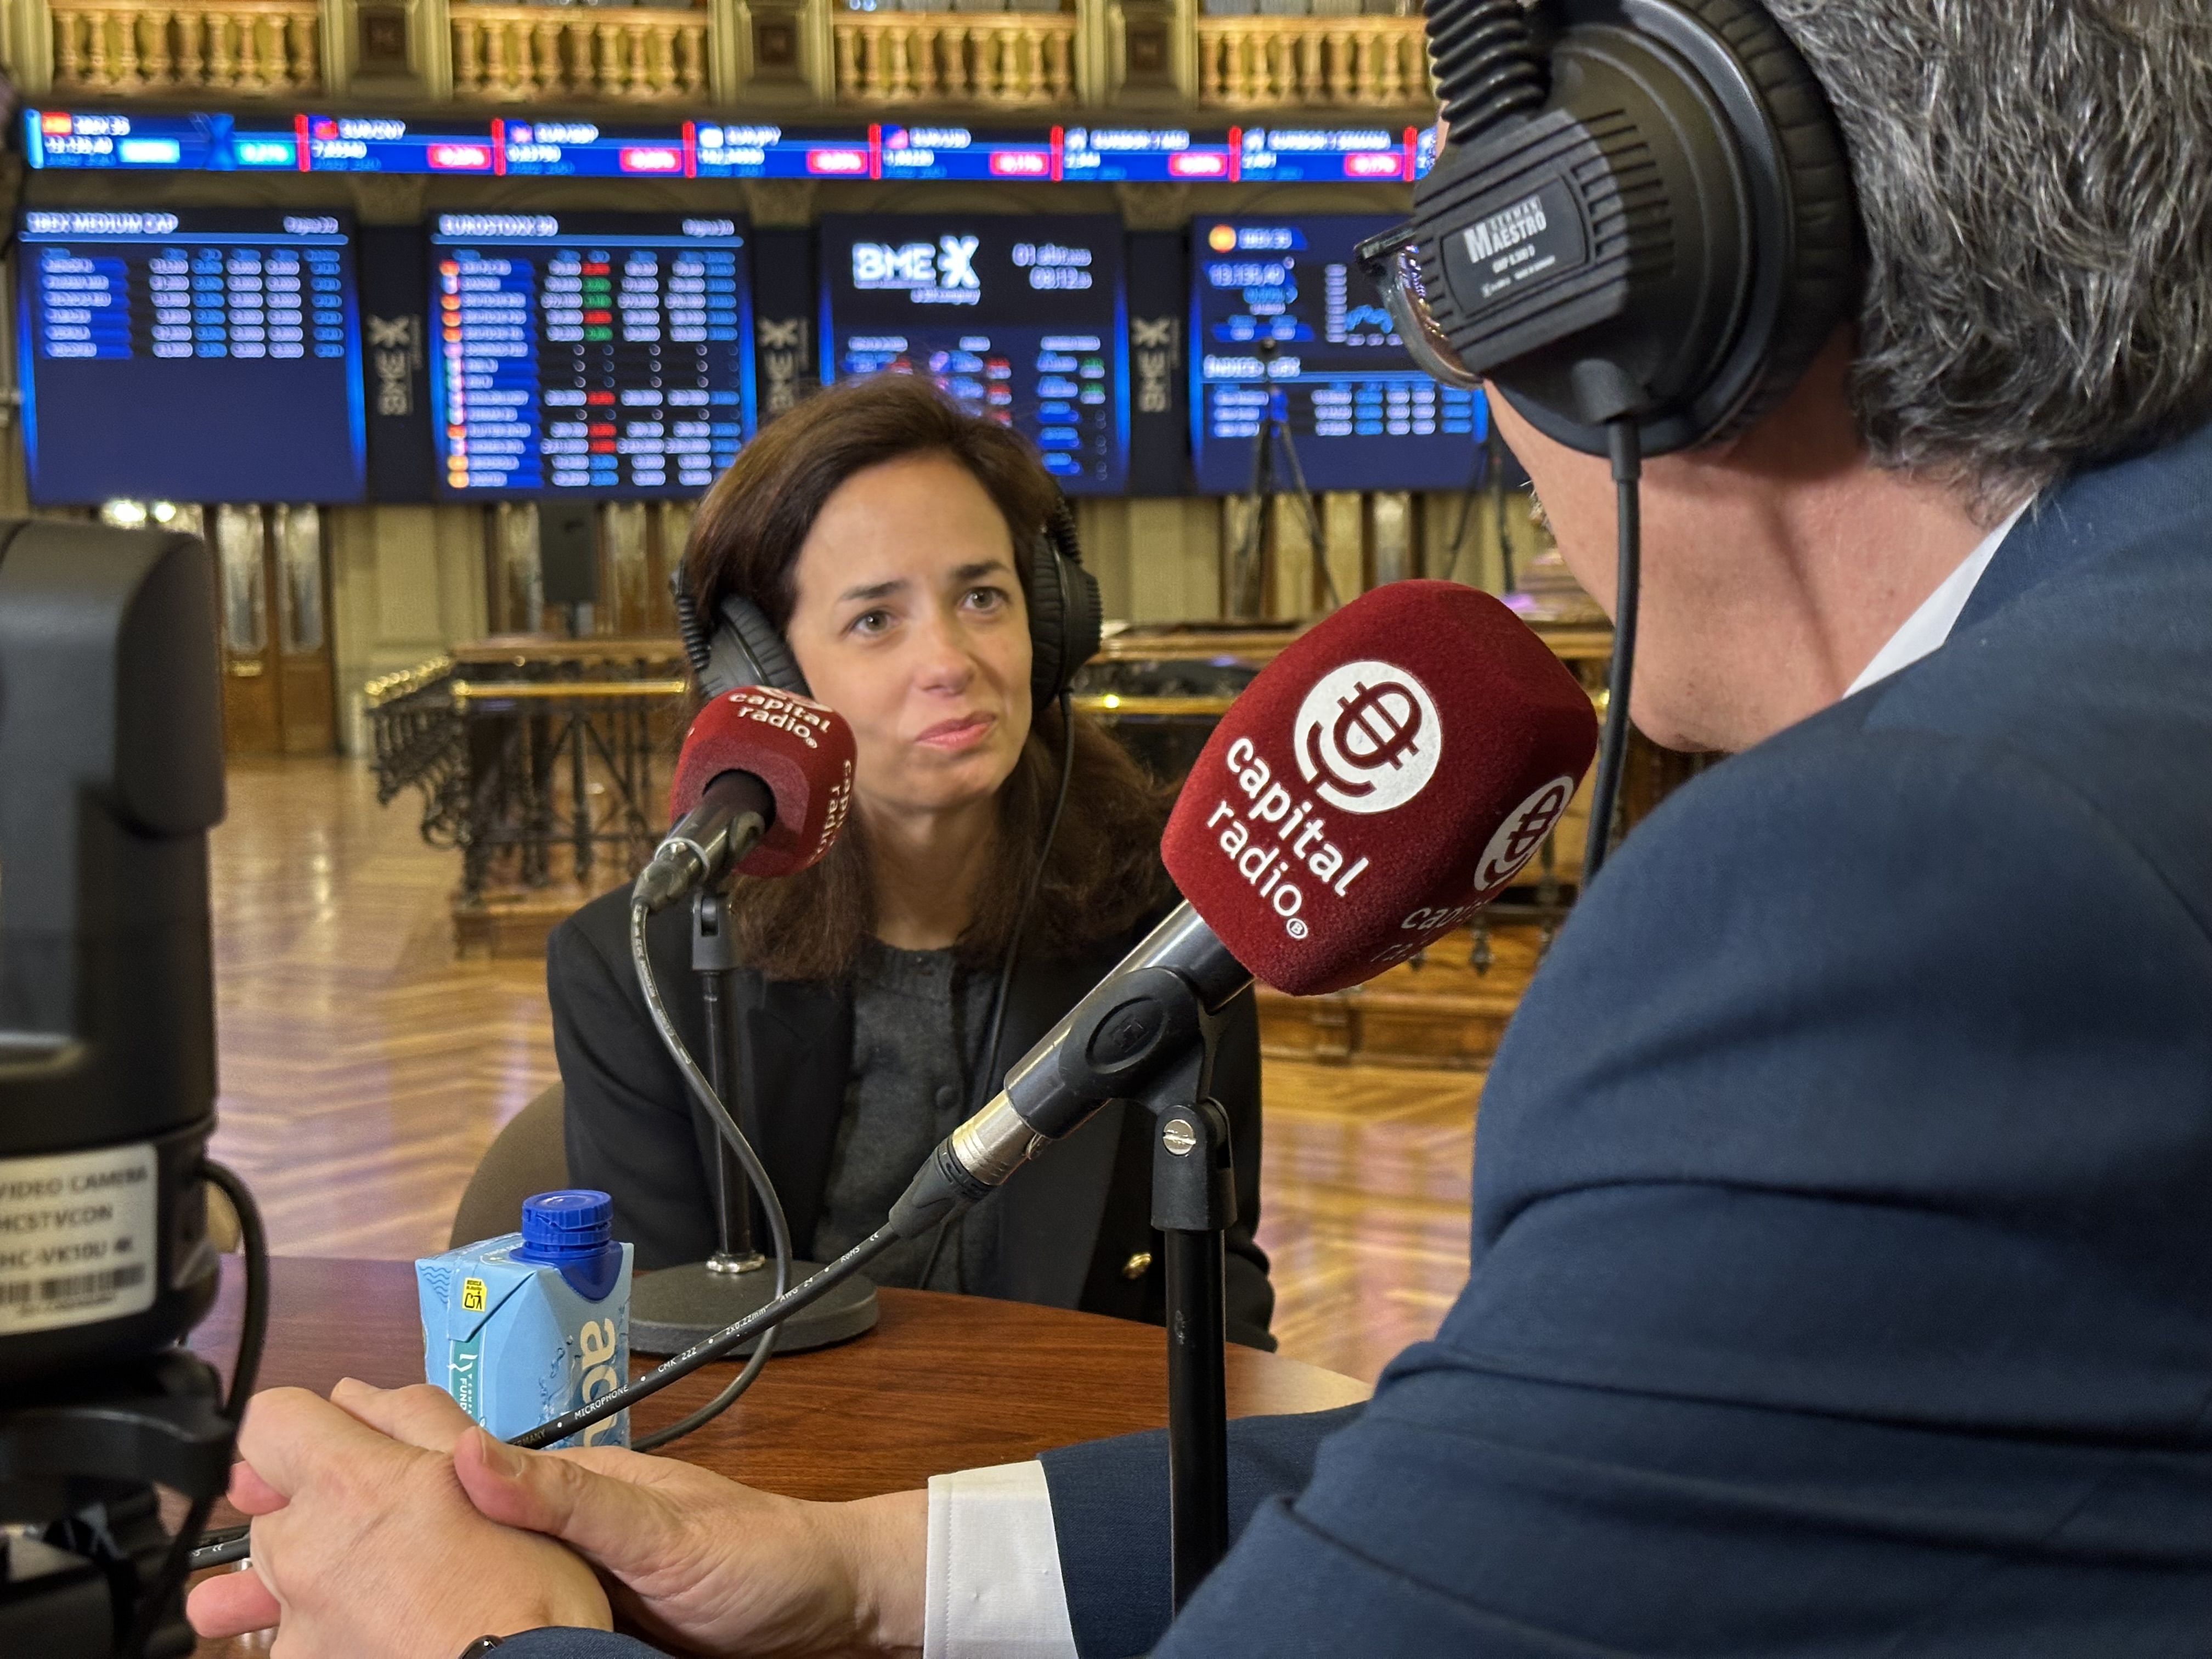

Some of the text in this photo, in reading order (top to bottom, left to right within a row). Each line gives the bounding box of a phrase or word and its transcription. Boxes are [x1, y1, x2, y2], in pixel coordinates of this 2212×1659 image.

[1464, 210, 1547, 263] MAESTRO
[728, 693, 831, 733] capital
[1226, 737, 1370, 898] capital
[574, 1384, 630, 1420] MICROPHONE
[658, 1358, 678, 1373] CMK
[681, 1347, 697, 1361] 222
